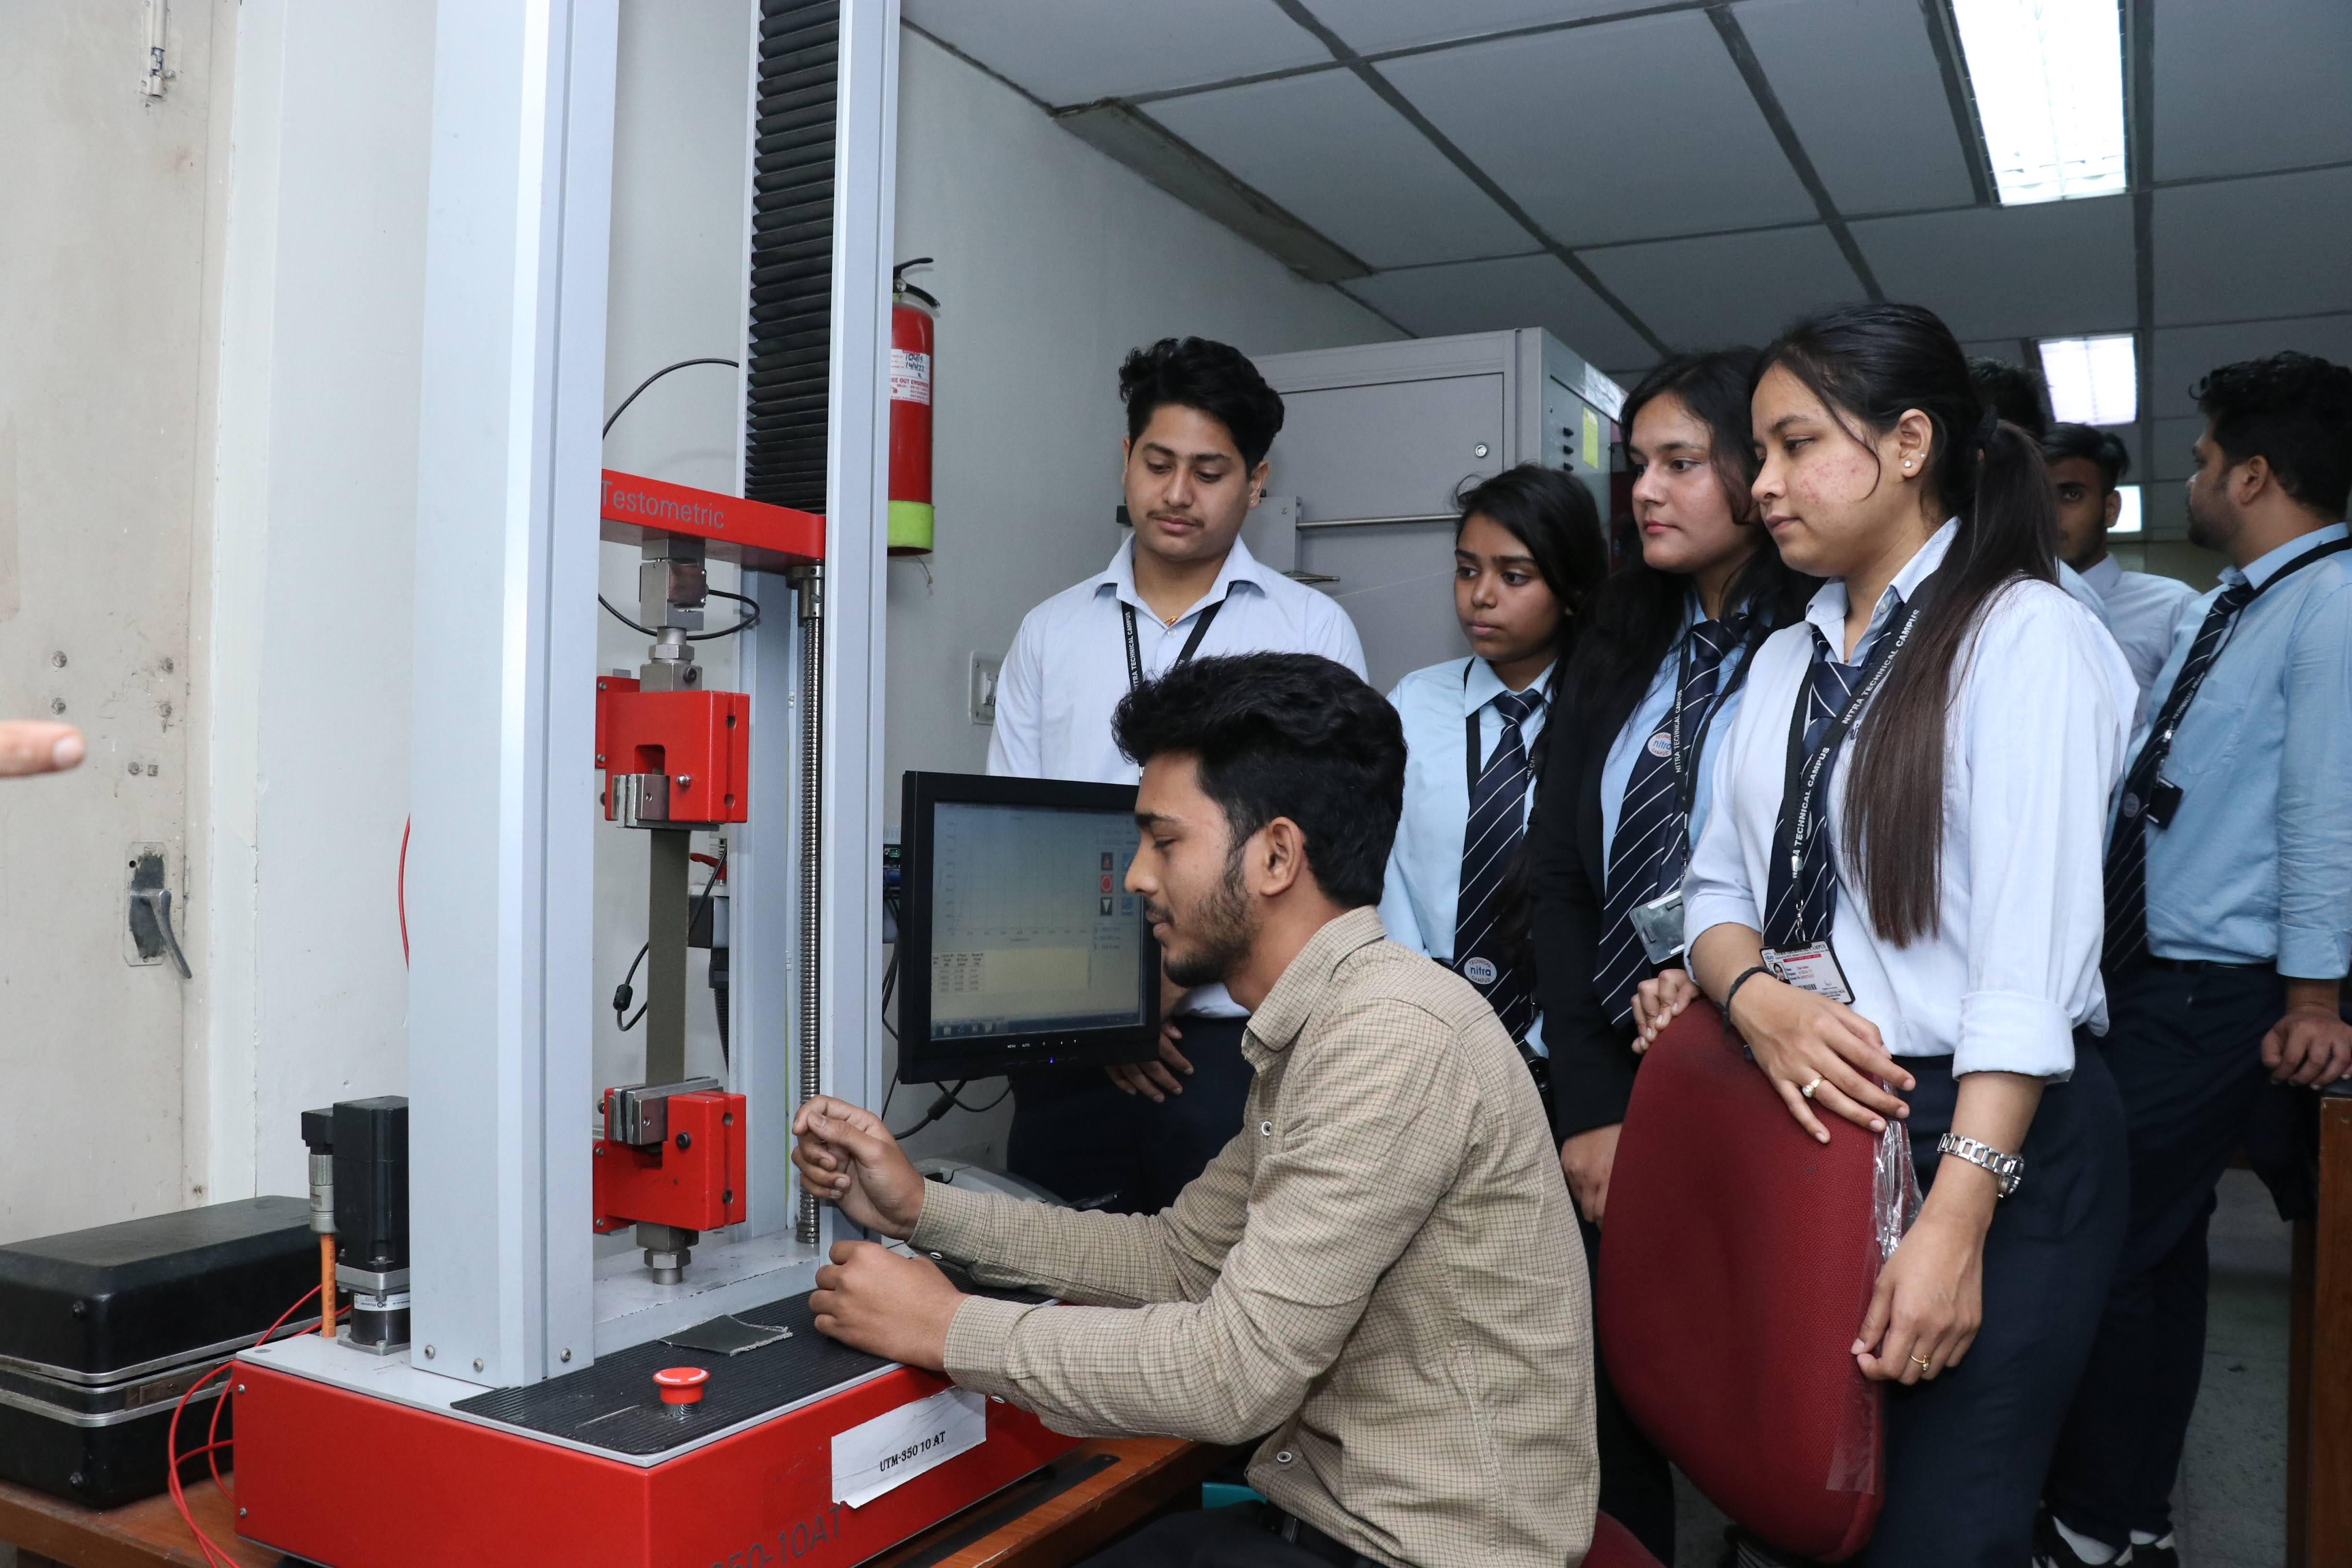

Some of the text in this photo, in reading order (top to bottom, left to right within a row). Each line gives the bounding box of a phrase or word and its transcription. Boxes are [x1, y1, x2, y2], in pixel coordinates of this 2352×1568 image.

[601, 481, 725, 529] Testometric
[1128, 635, 1137, 670] TECHNICAL
[1842, 695, 1864, 725] NITRA
[1862, 649, 1897, 700] TECHNICAL
[1896, 609, 1920, 646] CAMPUS
[1653, 740, 1672, 751] nitra
[1794, 790, 1811, 846] TECHNICAL
[1807, 747, 1830, 787] CAMPUS
[1468, 960, 1491, 968] TECHNICAL
[1470, 966, 1491, 976] nitra
[880, 1431, 946, 1472] UTM-350 10 AT
